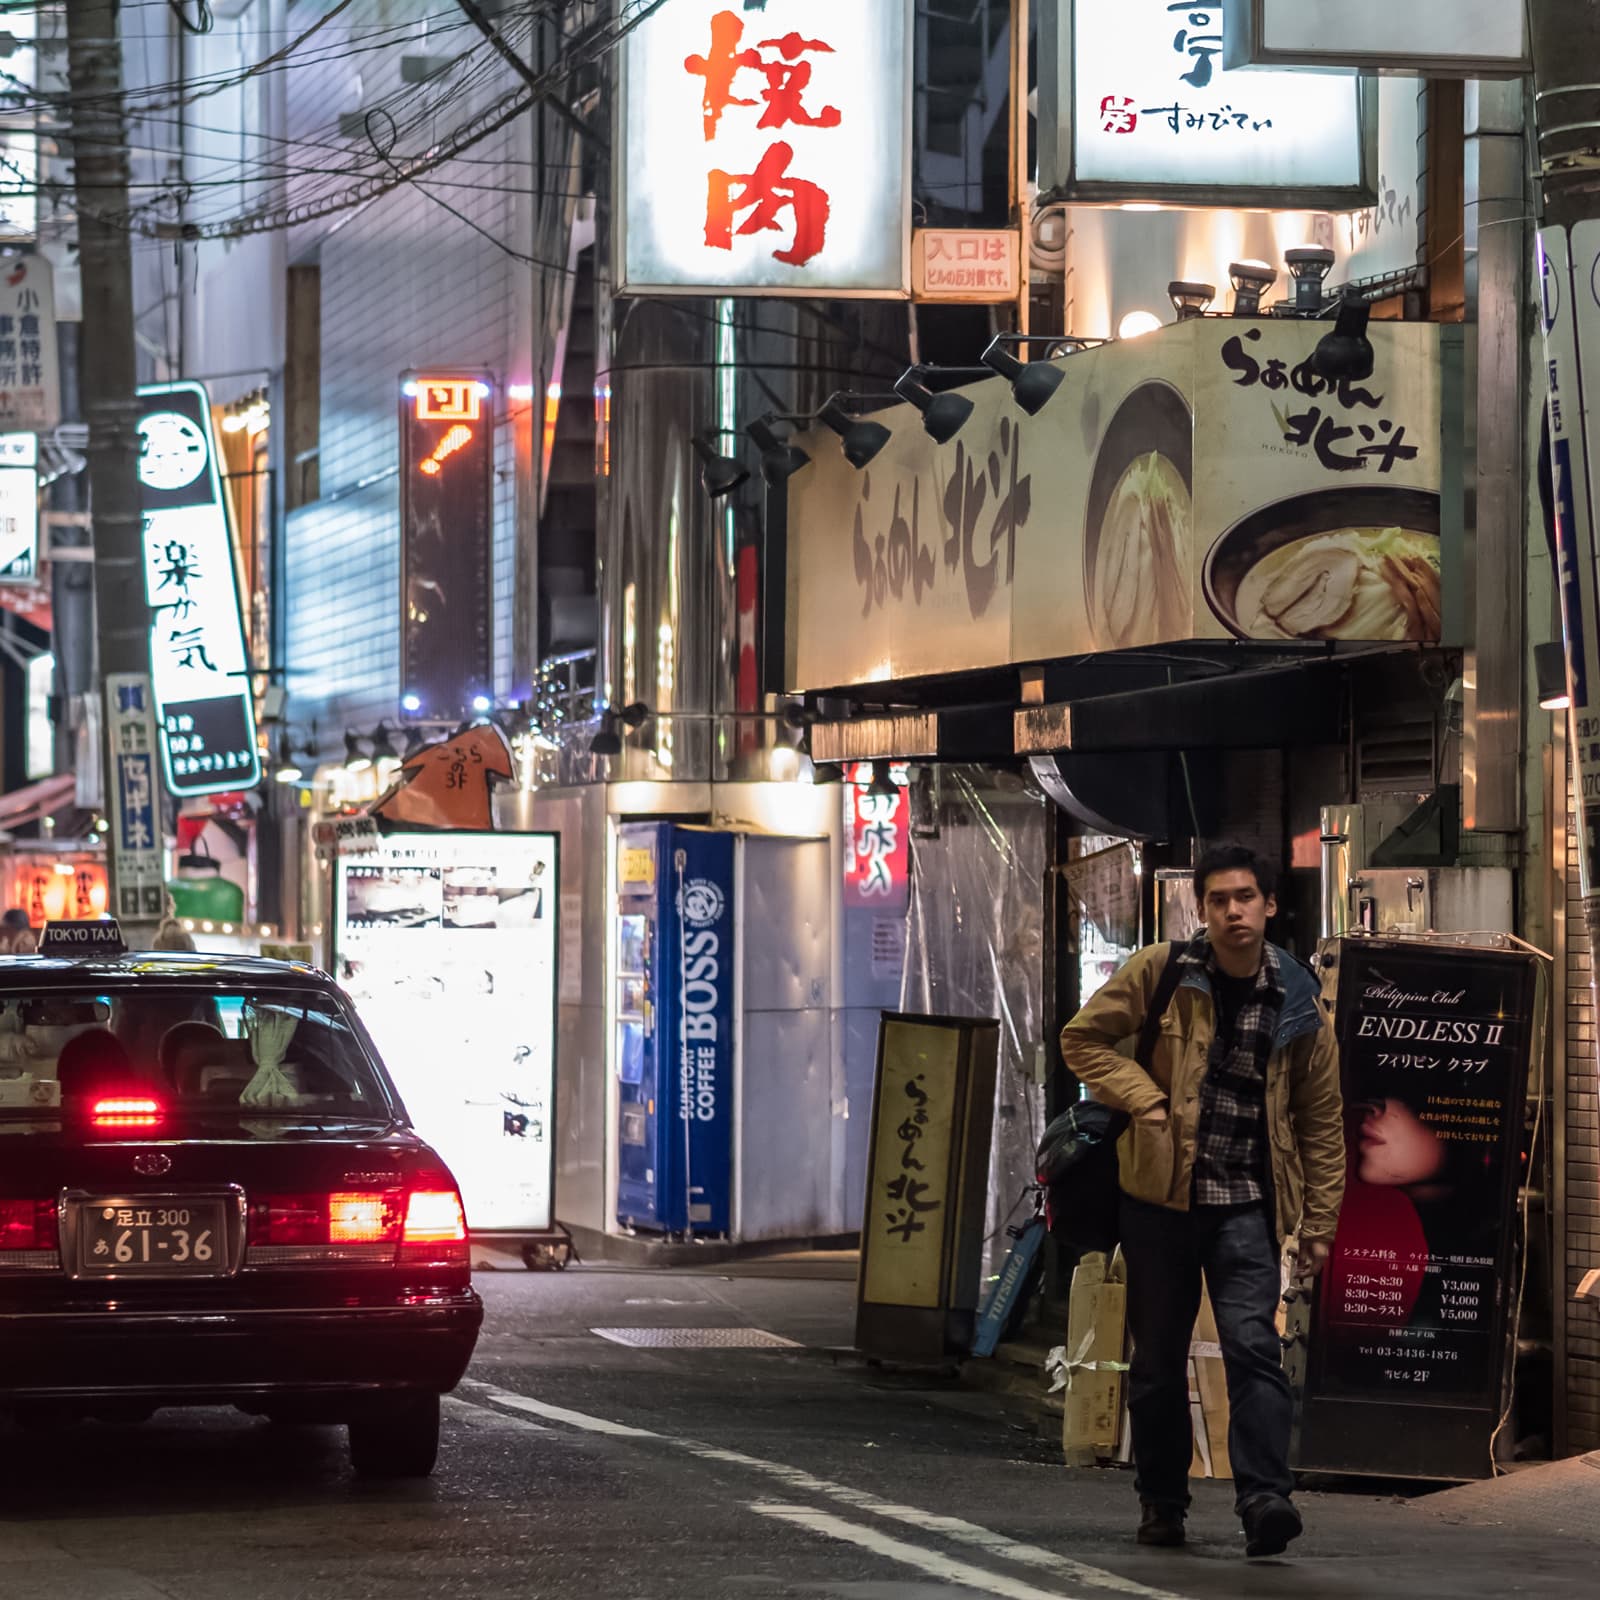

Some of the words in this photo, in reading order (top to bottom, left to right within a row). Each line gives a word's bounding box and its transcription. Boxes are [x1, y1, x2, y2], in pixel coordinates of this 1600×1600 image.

[1141, 102, 1272, 134] すみびてい
[684, 10, 841, 267] 焼肉
[927, 238, 1006, 261] 入口は
[1284, 406, 1418, 473] 北斗
[48, 928, 88, 941] TOKYO
[91, 928, 118, 941] TAXI
[680, 931, 719, 1042] BOSS
[1363, 985, 1429, 1009] Philippine
[1431, 989, 1466, 1005] Club
[1357, 1016, 1480, 1044] ENDLESS
[1484, 1025, 1504, 1045] II
[1376, 1053, 1440, 1069] フィリピン
[1447, 1058, 1489, 1074] クラブ
[679, 1046, 695, 1120] SUNTORY
[698, 1047, 716, 1122] COFFEE
[116, 1209, 153, 1227] 足立
[156, 1209, 190, 1226] 300
[93, 1239, 109, 1256] あ
[114, 1229, 212, 1262] 61-36
[1377, 1346, 1458, 1360] 03-3436-1876
[1413, 1370, 1430, 1382] 2F
